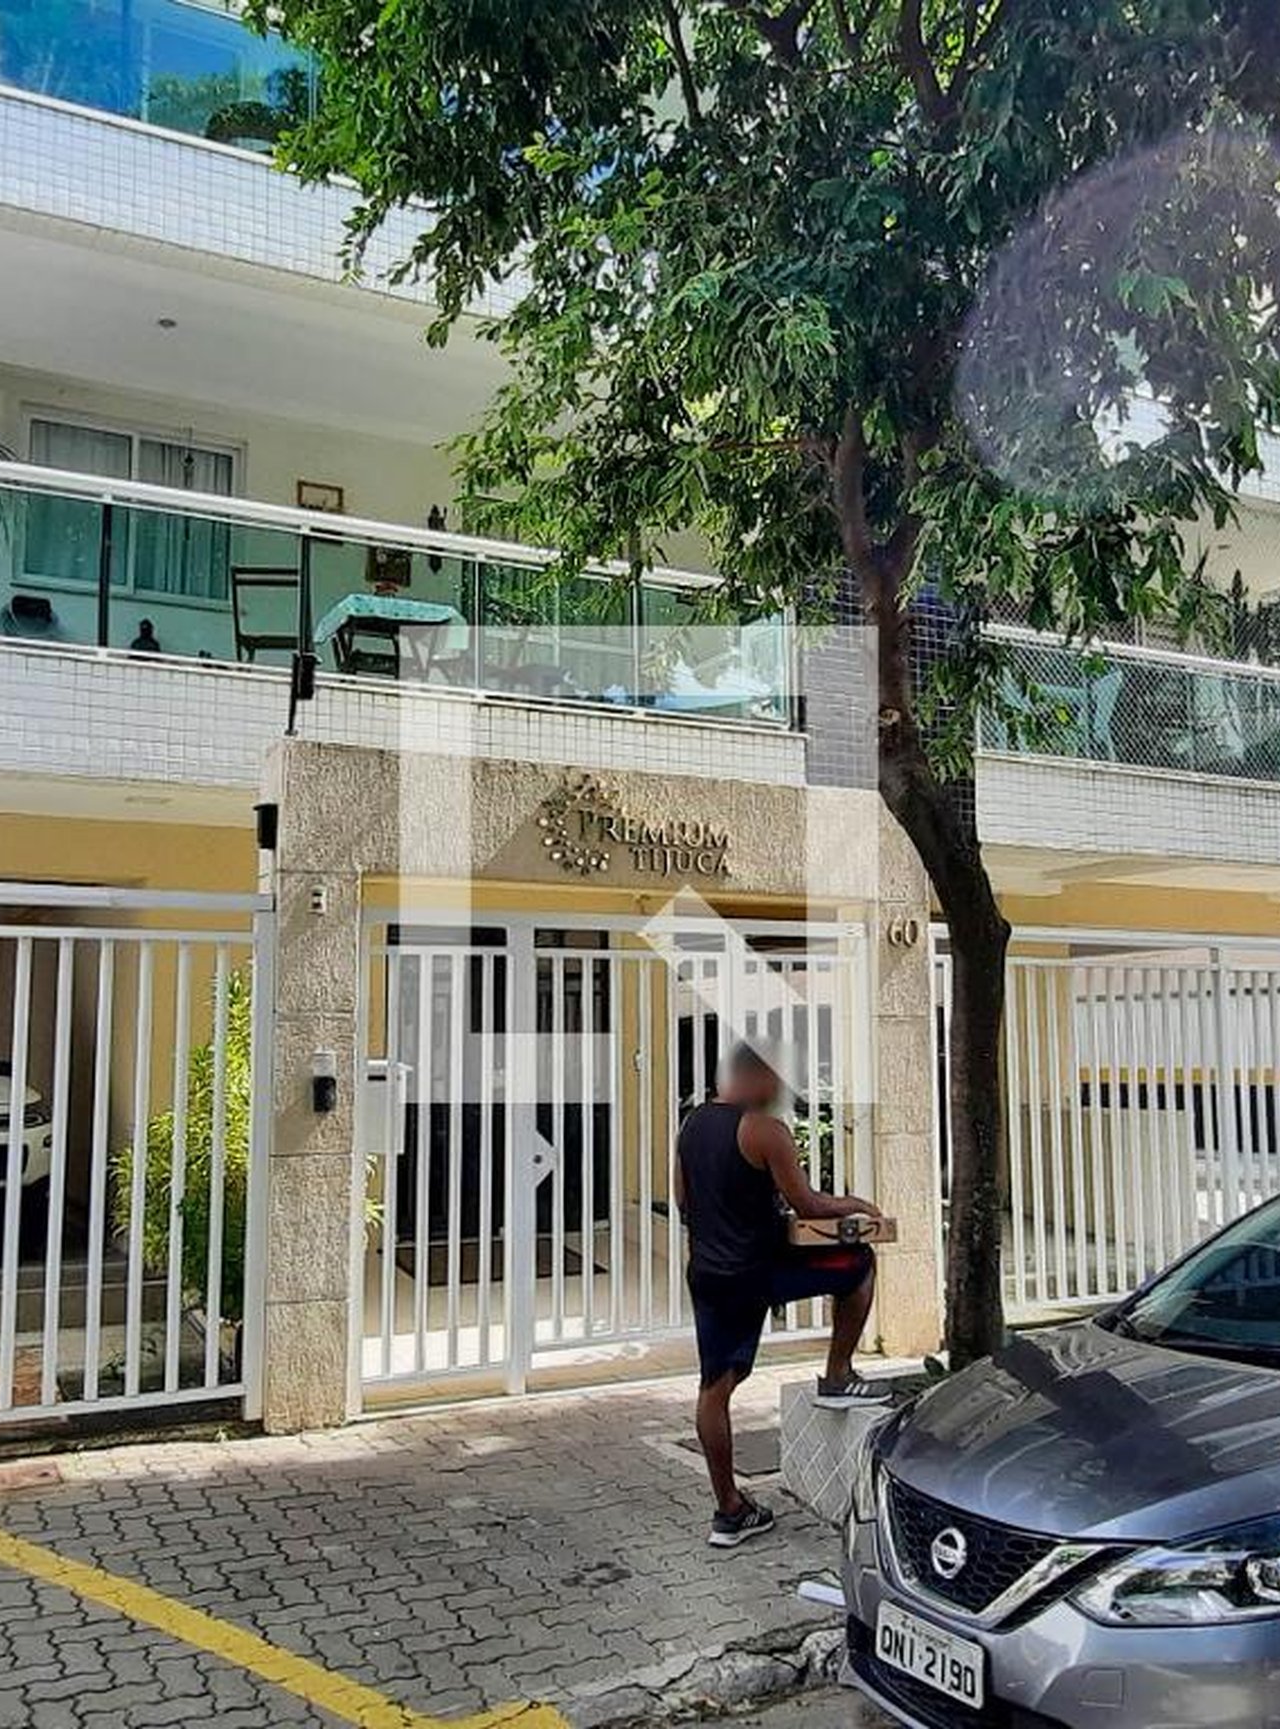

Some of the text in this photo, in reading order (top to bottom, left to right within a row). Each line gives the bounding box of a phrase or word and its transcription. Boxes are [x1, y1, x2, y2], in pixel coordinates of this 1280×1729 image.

[577, 809, 732, 848] PREMIUM
[631, 846, 732, 876] TIJUCA
[887, 914, 918, 948] 60
